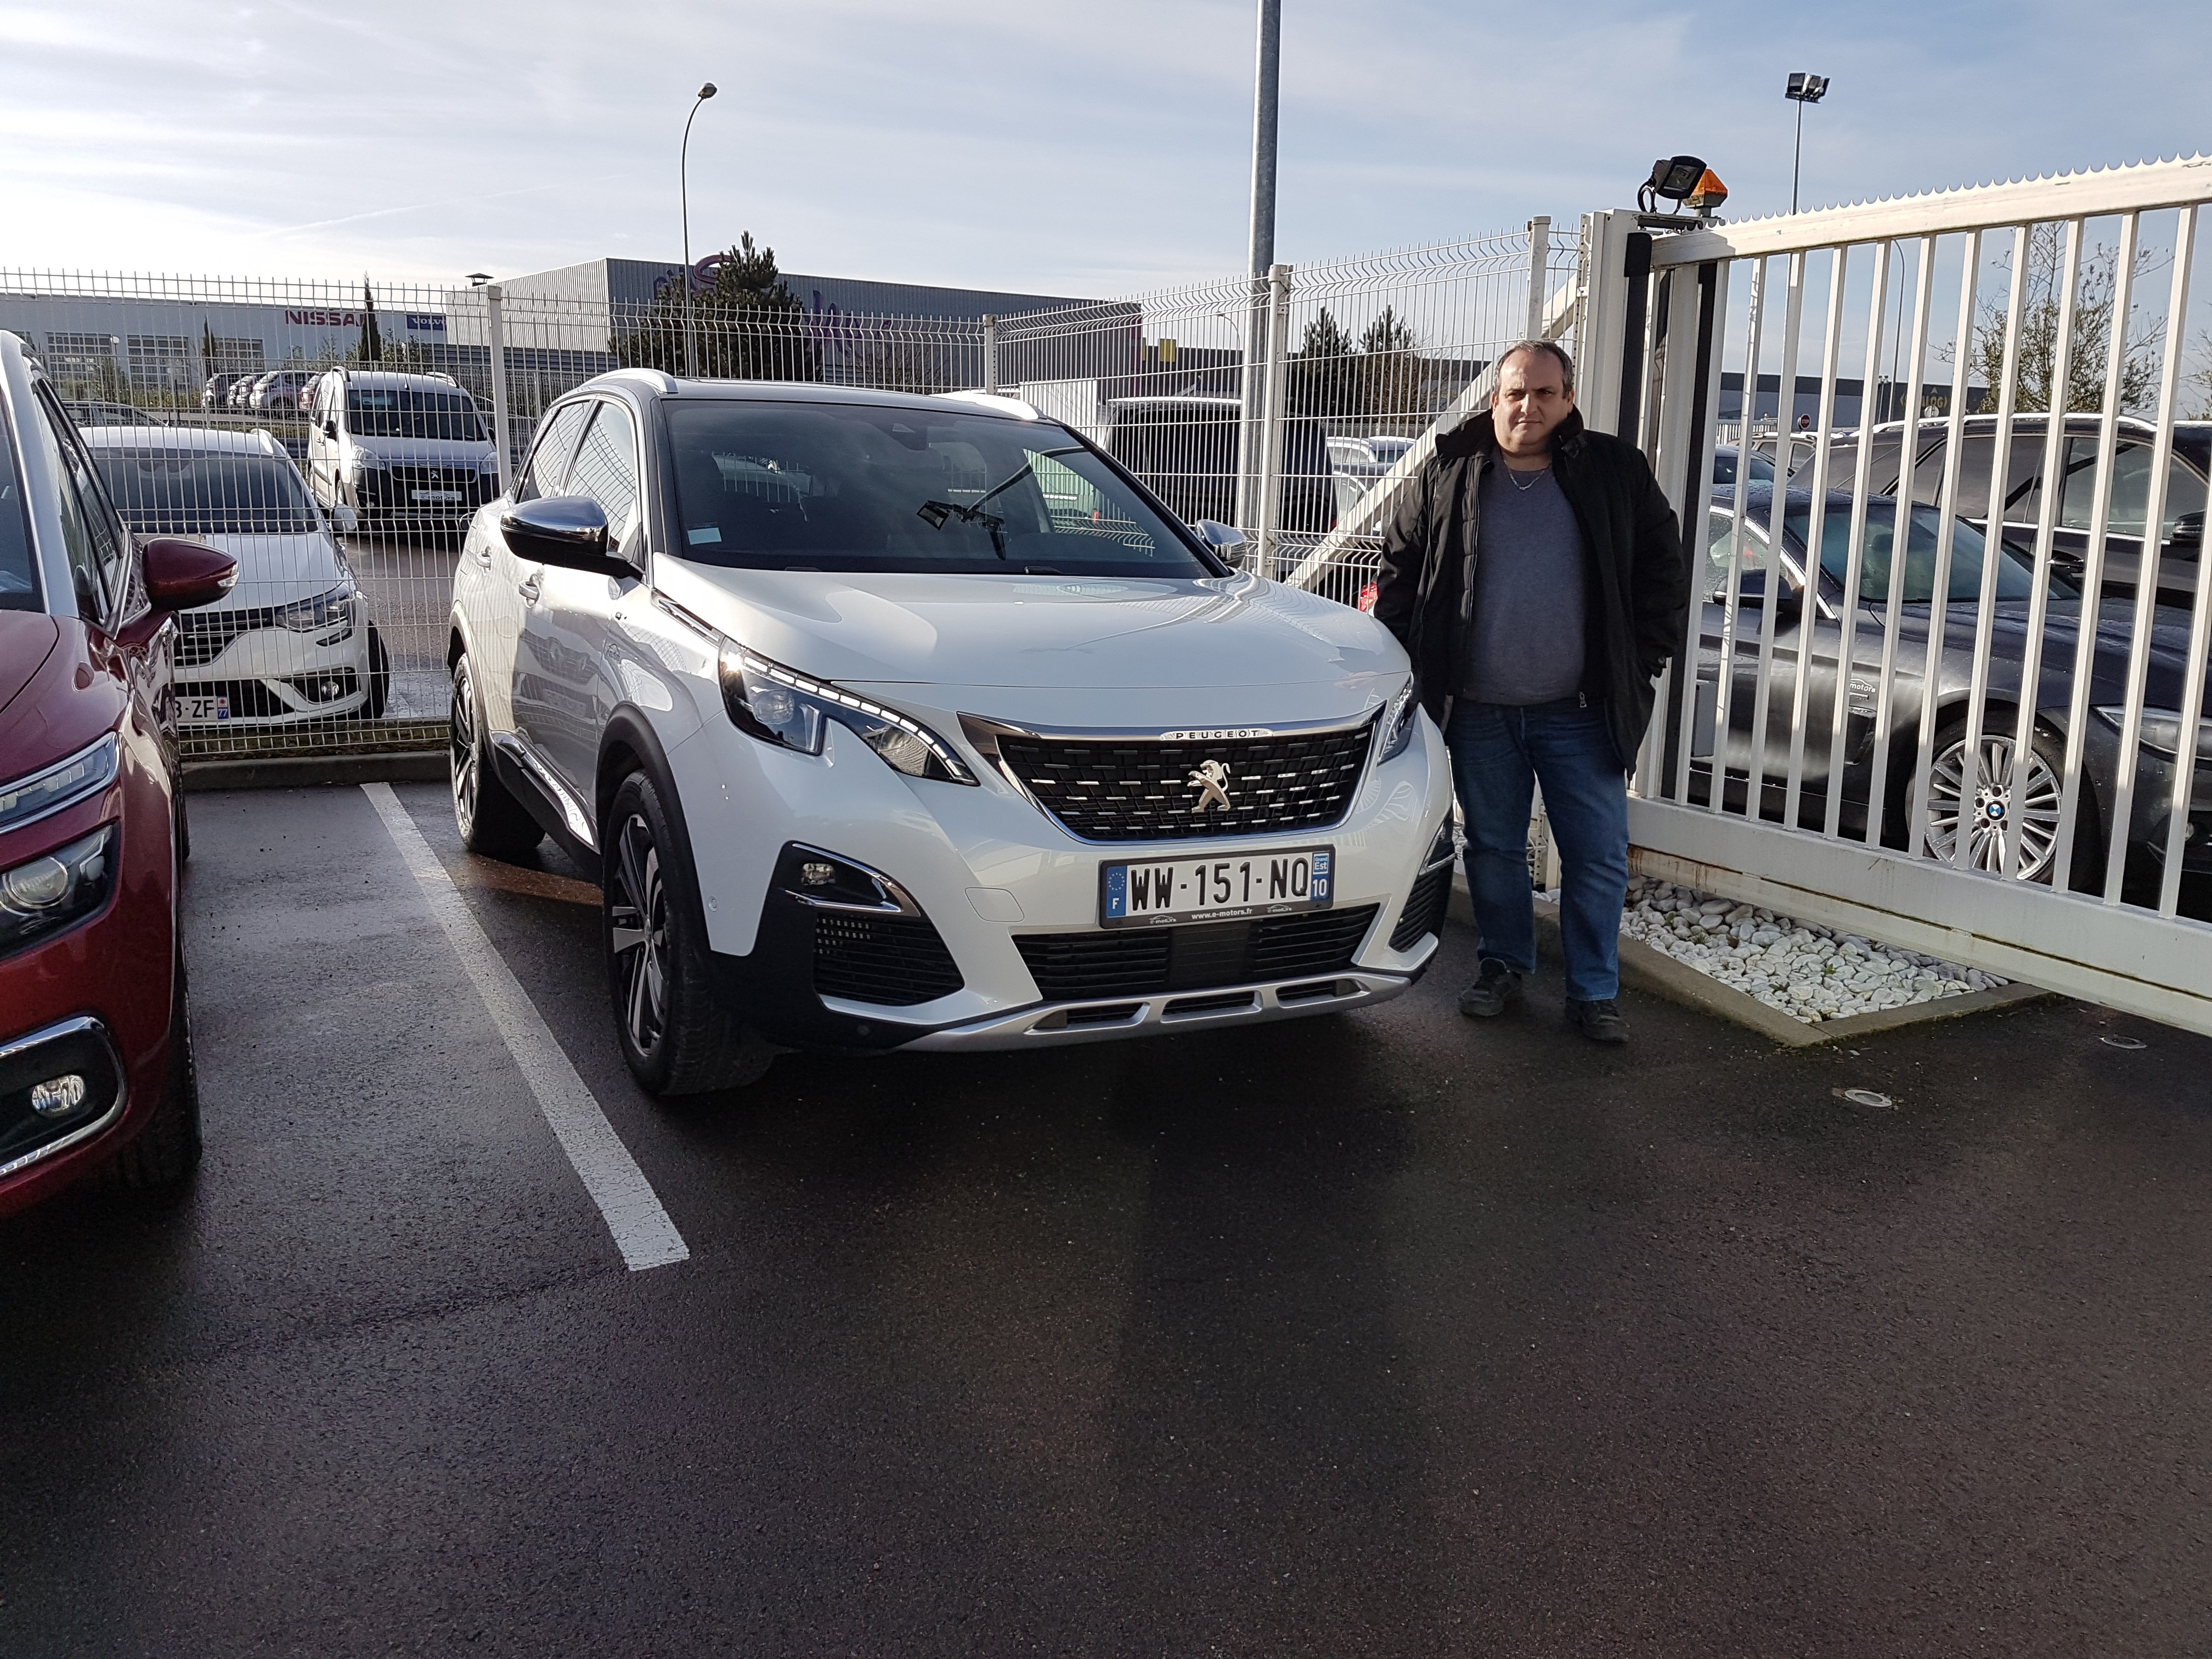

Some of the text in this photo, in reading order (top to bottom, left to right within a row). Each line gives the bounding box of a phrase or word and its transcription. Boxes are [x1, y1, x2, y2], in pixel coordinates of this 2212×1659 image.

[1850, 683, 1876, 693] motors
[218, 708, 228, 717] 77
[1176, 730, 1259, 740] PEUGEOT
[1314, 861, 1328, 870] Est
[1131, 857, 1309, 911] WW-151-NQ
[1312, 878, 1327, 896] 10
[1112, 898, 1120, 910] F
[1191, 907, 1253, 919] www.e-motors.fr
